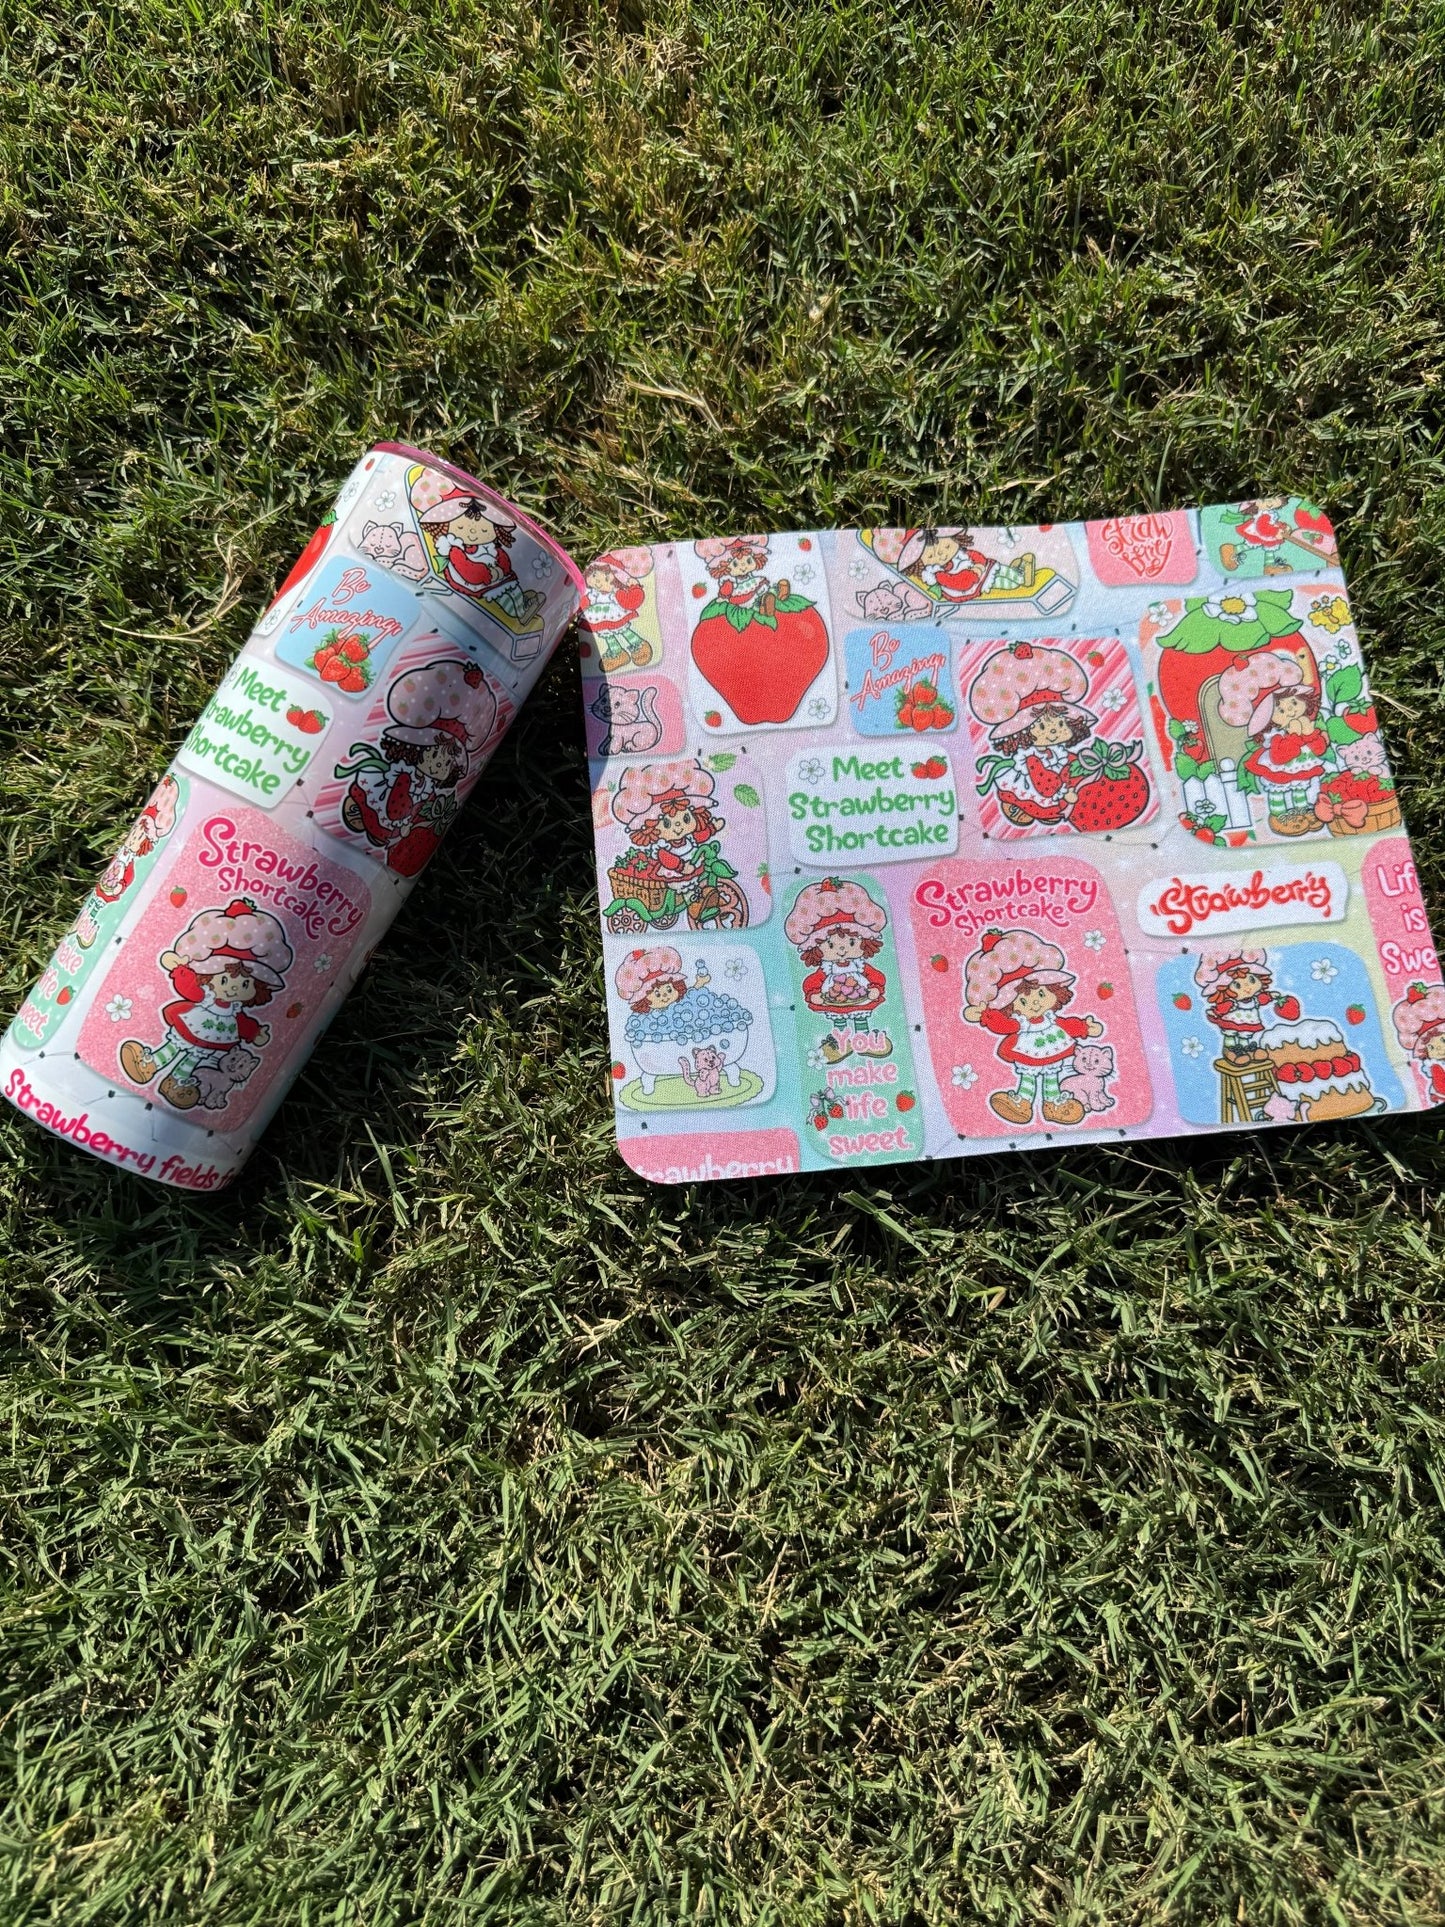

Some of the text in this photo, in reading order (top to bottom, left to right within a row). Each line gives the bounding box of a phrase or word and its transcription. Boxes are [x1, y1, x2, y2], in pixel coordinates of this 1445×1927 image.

[331, 566, 371, 605] Be
[869, 630, 901, 672] Be
[232, 667, 288, 712] Meet
[204, 697, 311, 774] trawberry
[832, 755, 905, 783] Meet
[788, 786, 956, 820] Strawberry
[805, 819, 949, 853] Shortcake
[198, 816, 364, 937] Strawberry
[1376, 860, 1418, 898] Lif
[217, 866, 326, 941] Shortcake
[915, 869, 1098, 927] Strawberry
[954, 896, 1071, 937] Shortcake
[1150, 870, 1332, 935] Strawberry
[1400, 902, 1427, 933] is
[1380, 940, 1438, 975] Swe
[831, 1026, 888, 1054] You
[826, 1060, 899, 1087] make
[844, 1091, 889, 1120] life
[4, 1068, 157, 1174] Strawberry
[158, 1154, 220, 1190] fields
[828, 1126, 914, 1157] sweet
